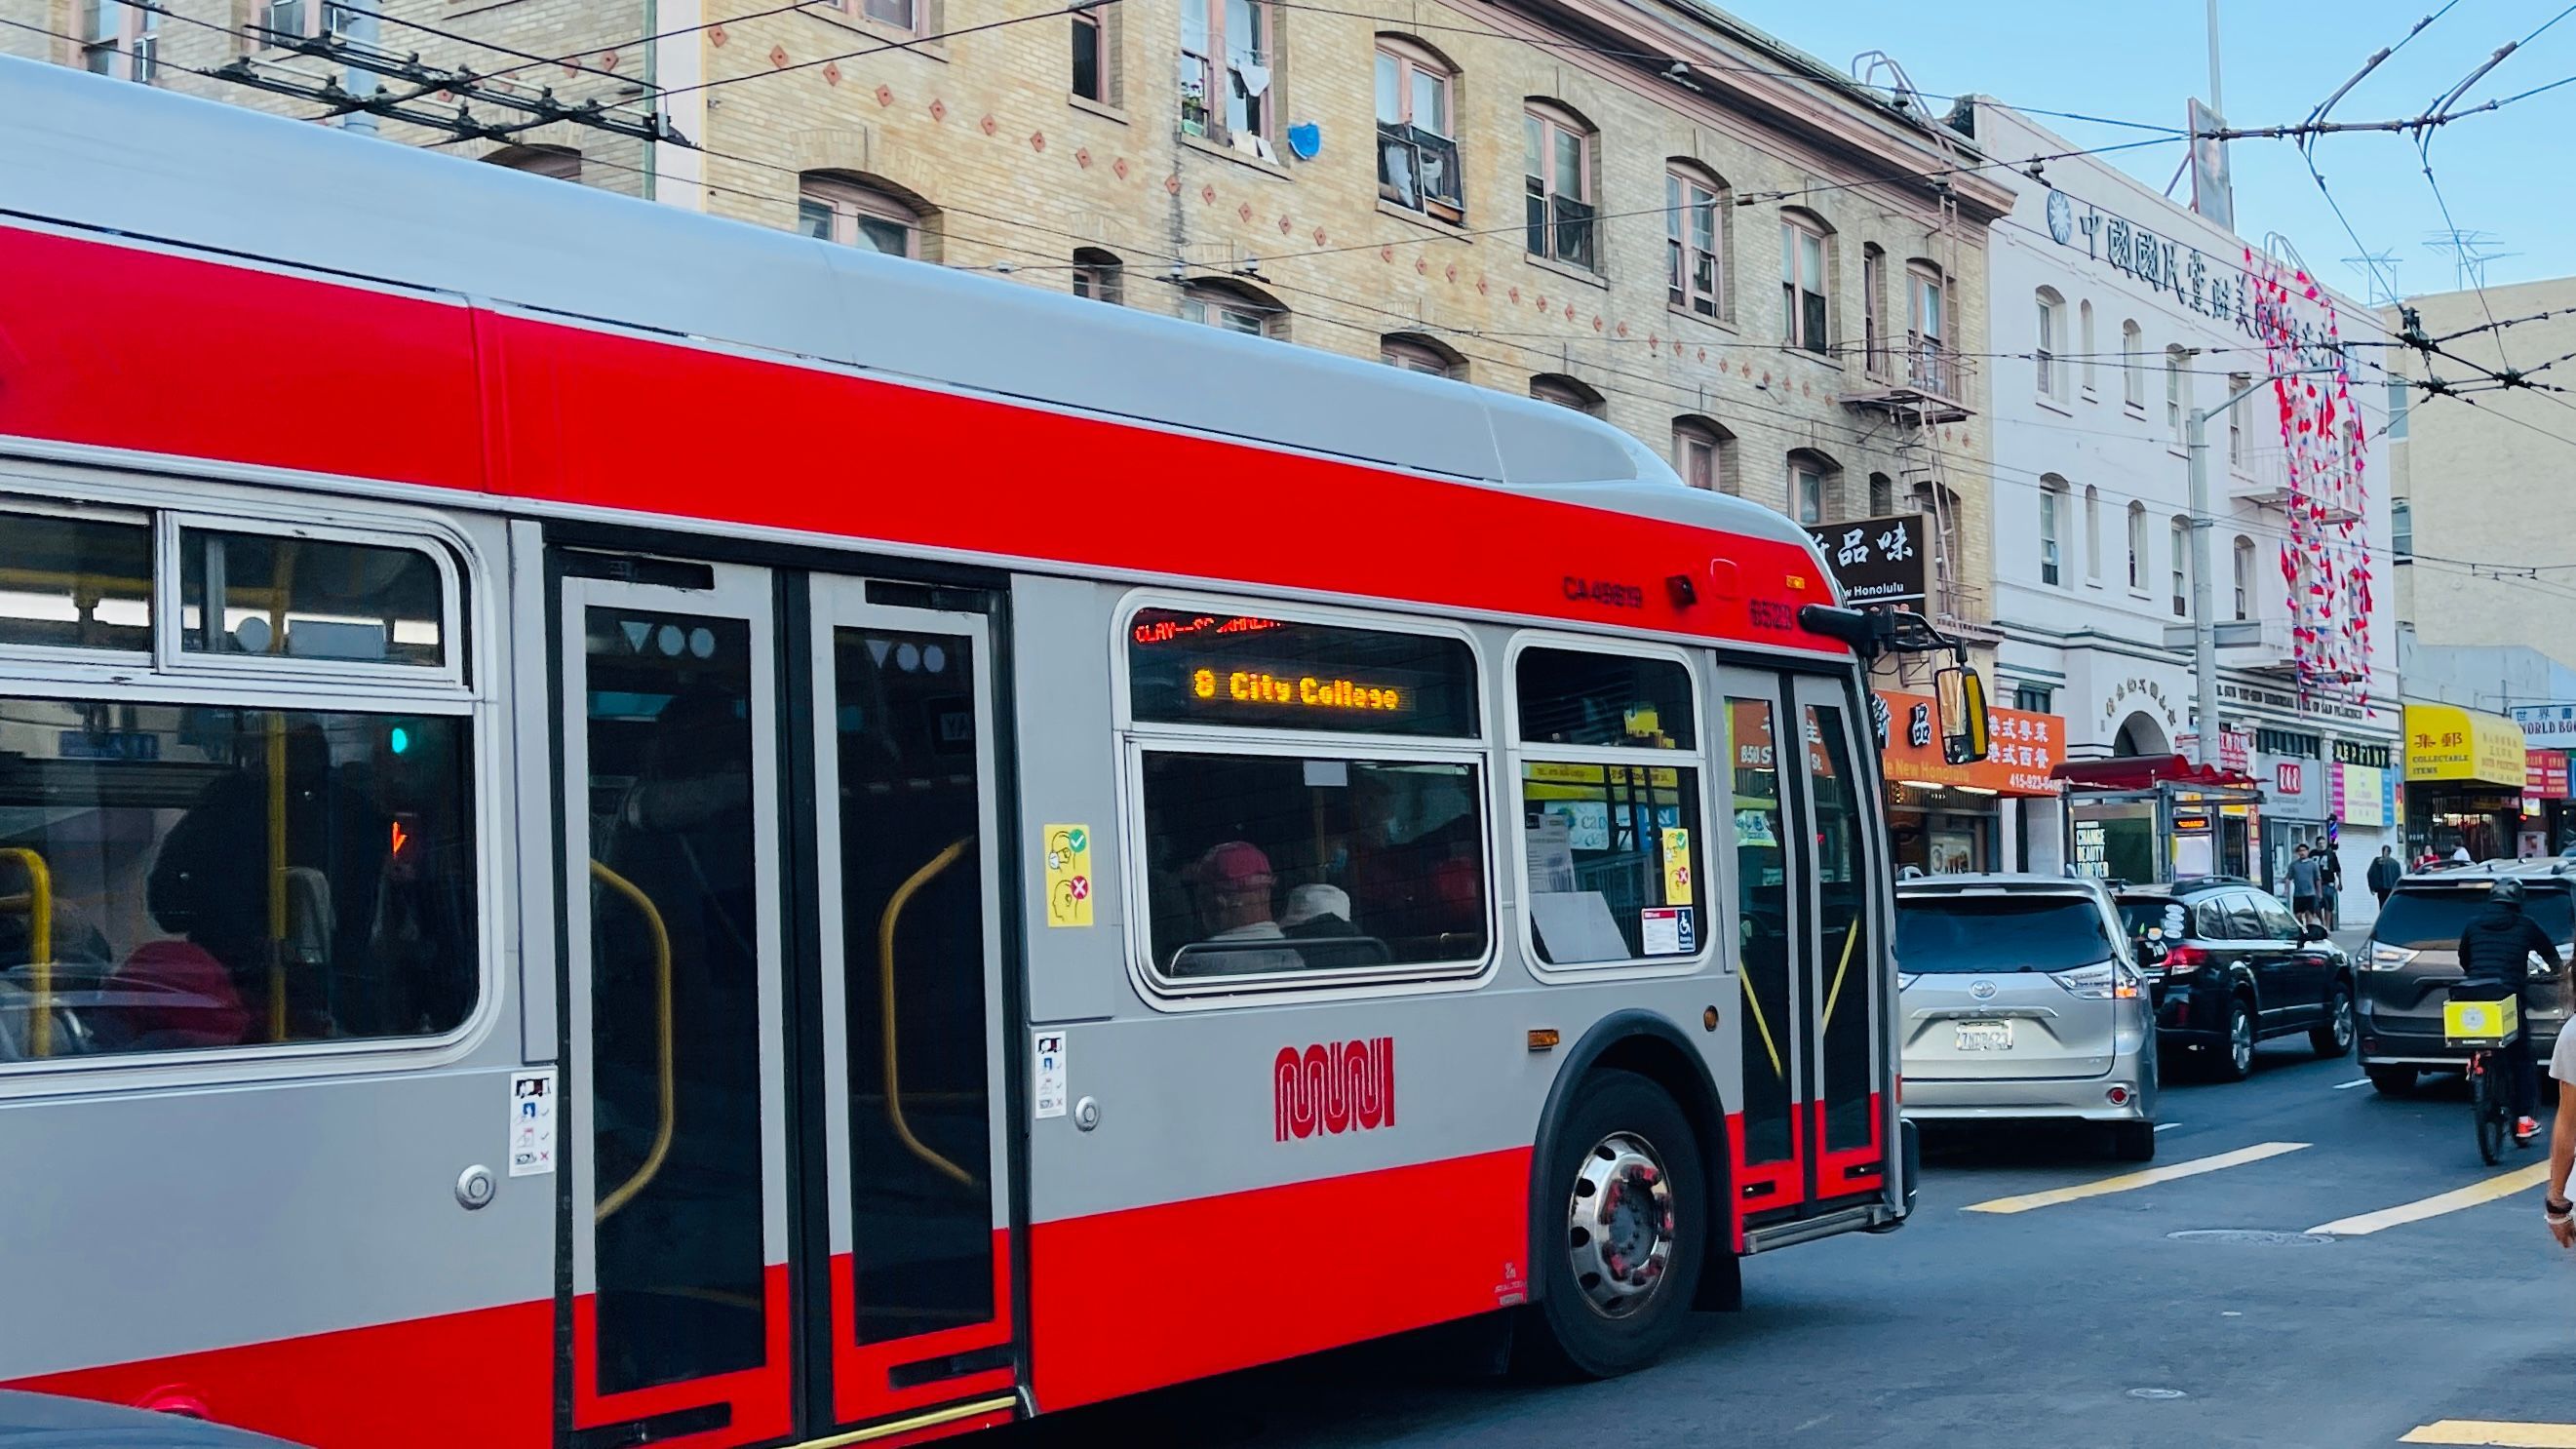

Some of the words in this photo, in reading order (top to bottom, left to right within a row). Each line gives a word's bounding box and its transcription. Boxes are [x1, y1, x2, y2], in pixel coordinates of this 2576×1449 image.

[1854, 582, 1904, 597] Honolulu
[1193, 668, 1216, 697] 8
[1229, 671, 1291, 701] City
[1299, 677, 1399, 709] College
[2412, 755, 2469, 764] COLLECTABLE
[1895, 762, 1920, 777] New
[2077, 845, 2104, 862] BEAUTY
